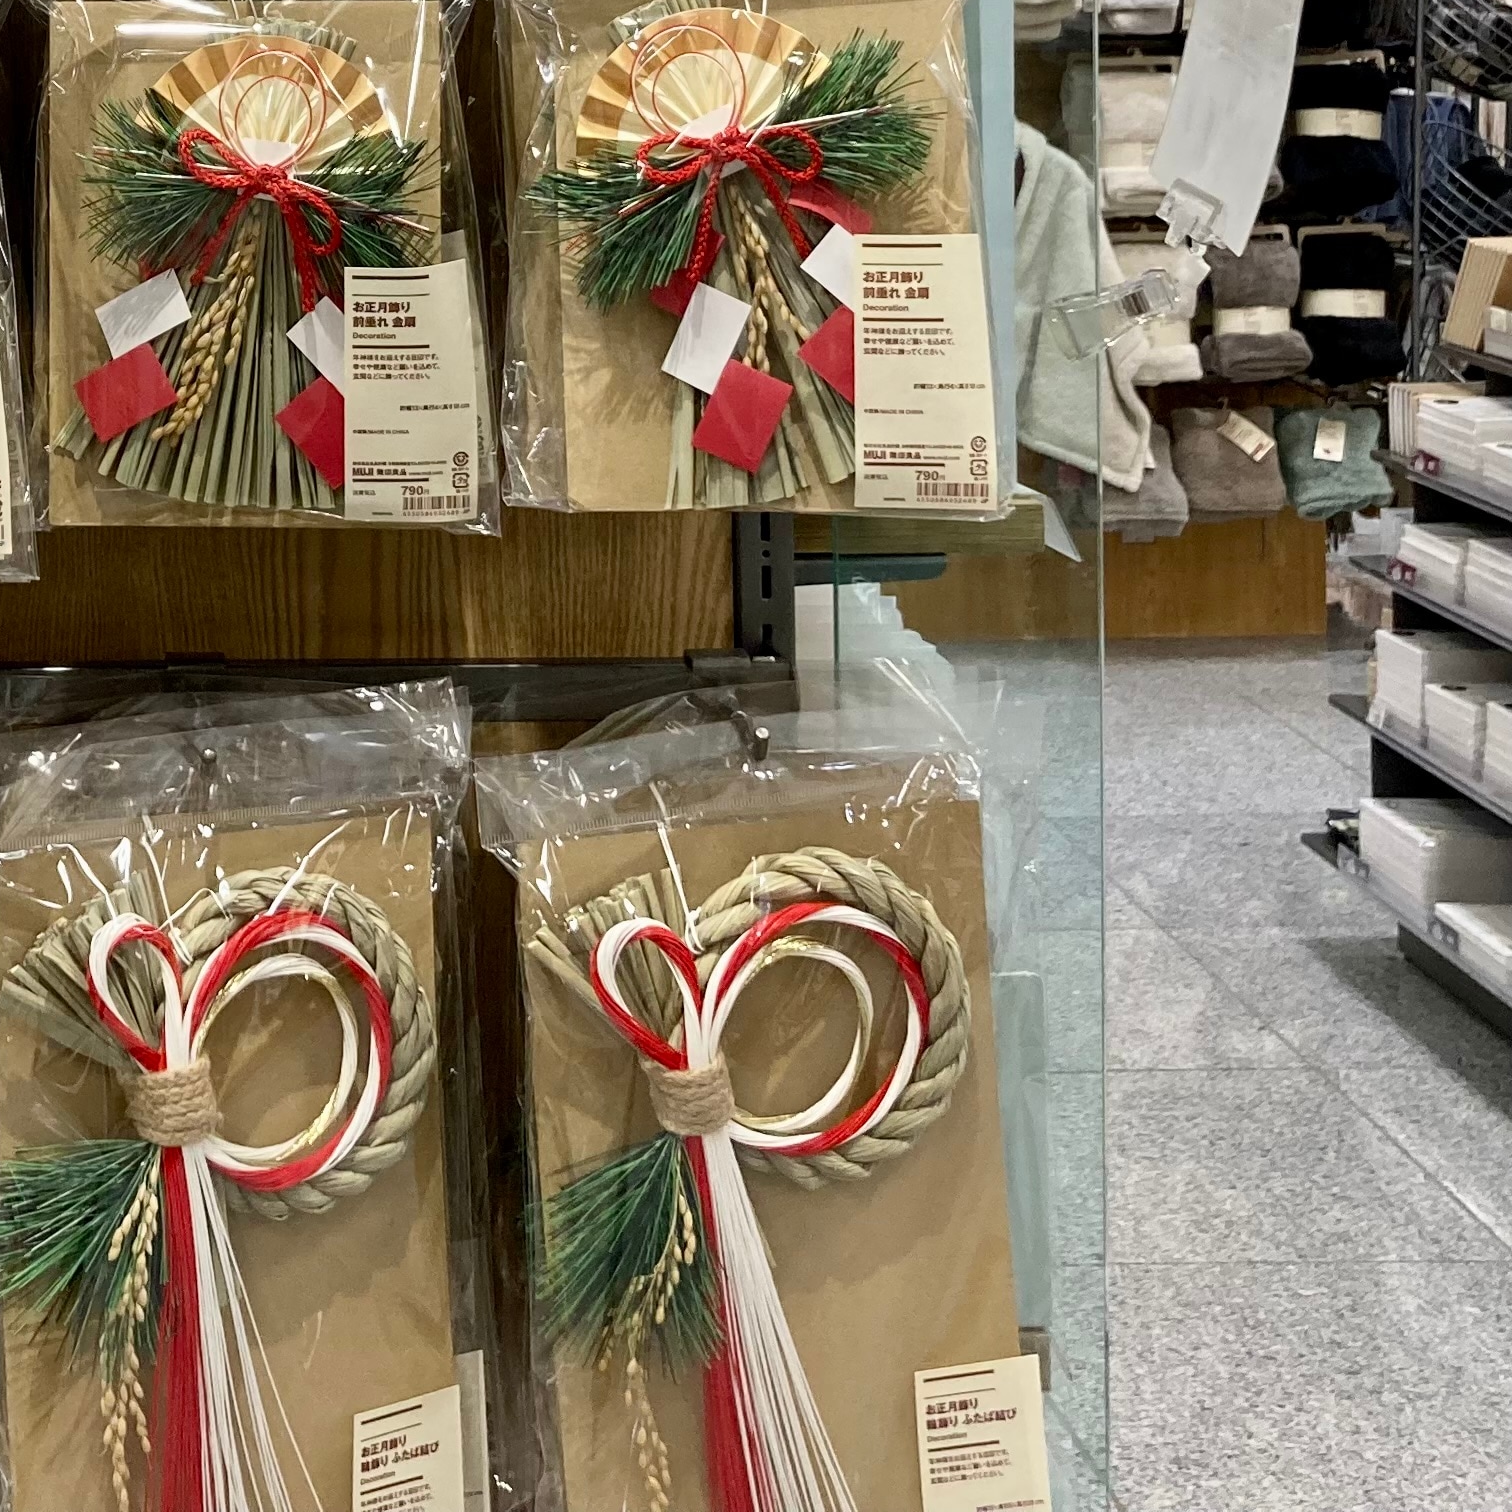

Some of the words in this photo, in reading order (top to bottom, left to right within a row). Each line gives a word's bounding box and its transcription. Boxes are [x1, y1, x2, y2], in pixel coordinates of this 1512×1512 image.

[863, 271, 924, 284] お正月飾り
[352, 301, 411, 313] お正月飾り
[862, 303, 909, 312] Decoration
[864, 450, 886, 459] MUJI
[352, 468, 374, 476] MUJI
